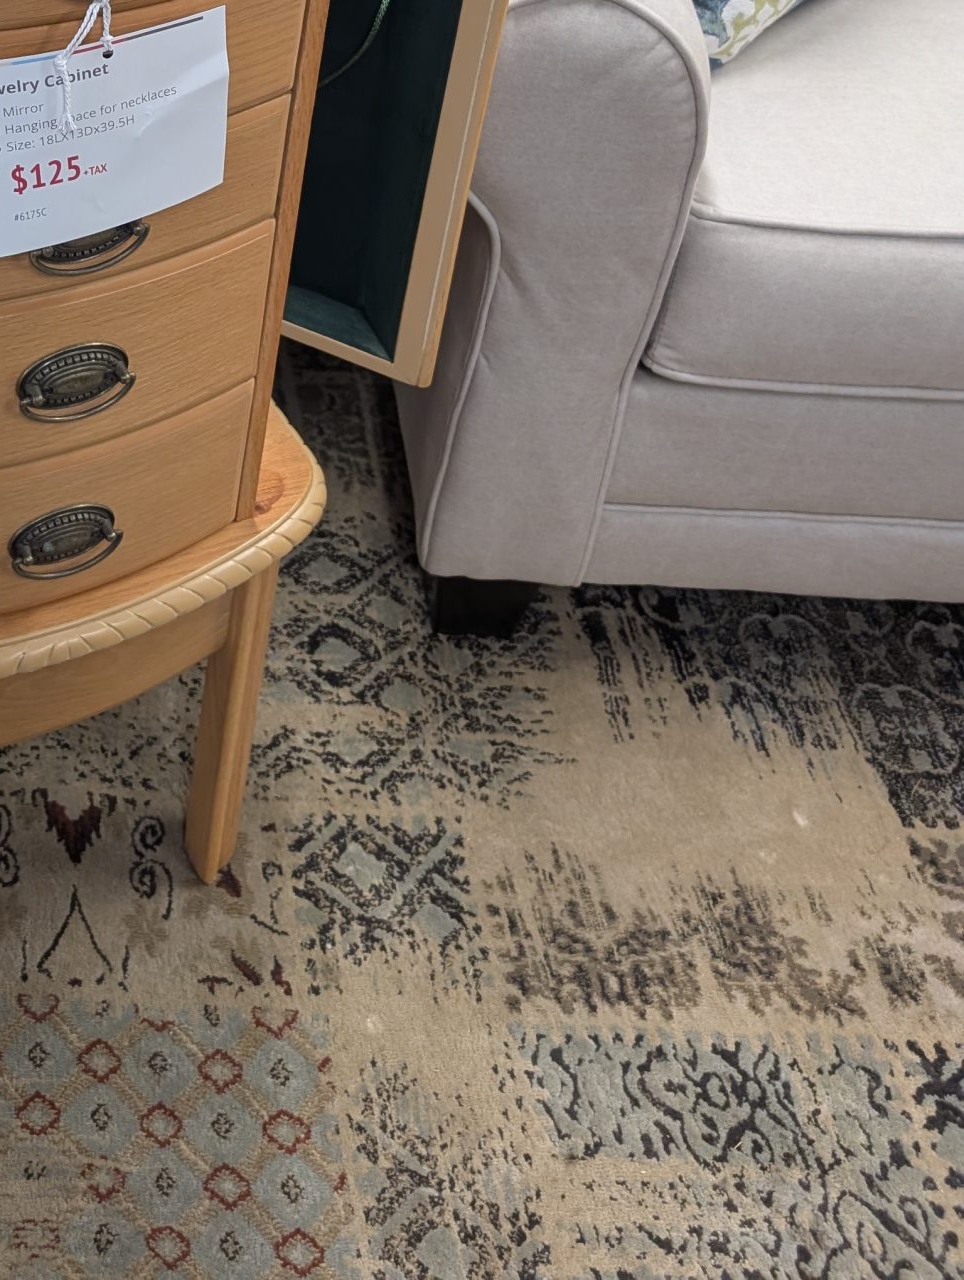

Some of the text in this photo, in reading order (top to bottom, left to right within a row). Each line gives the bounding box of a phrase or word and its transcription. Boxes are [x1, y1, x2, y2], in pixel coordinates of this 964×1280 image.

[2, 103, 44, 118] Mirror
[4, 118, 58, 135] Hanging
[100, 104, 117, 116] for
[120, 85, 178, 110] necklaces
[6, 139, 36, 153] Size:
[11, 155, 82, 195] $125
[14, 207, 48, 222] #6175C
